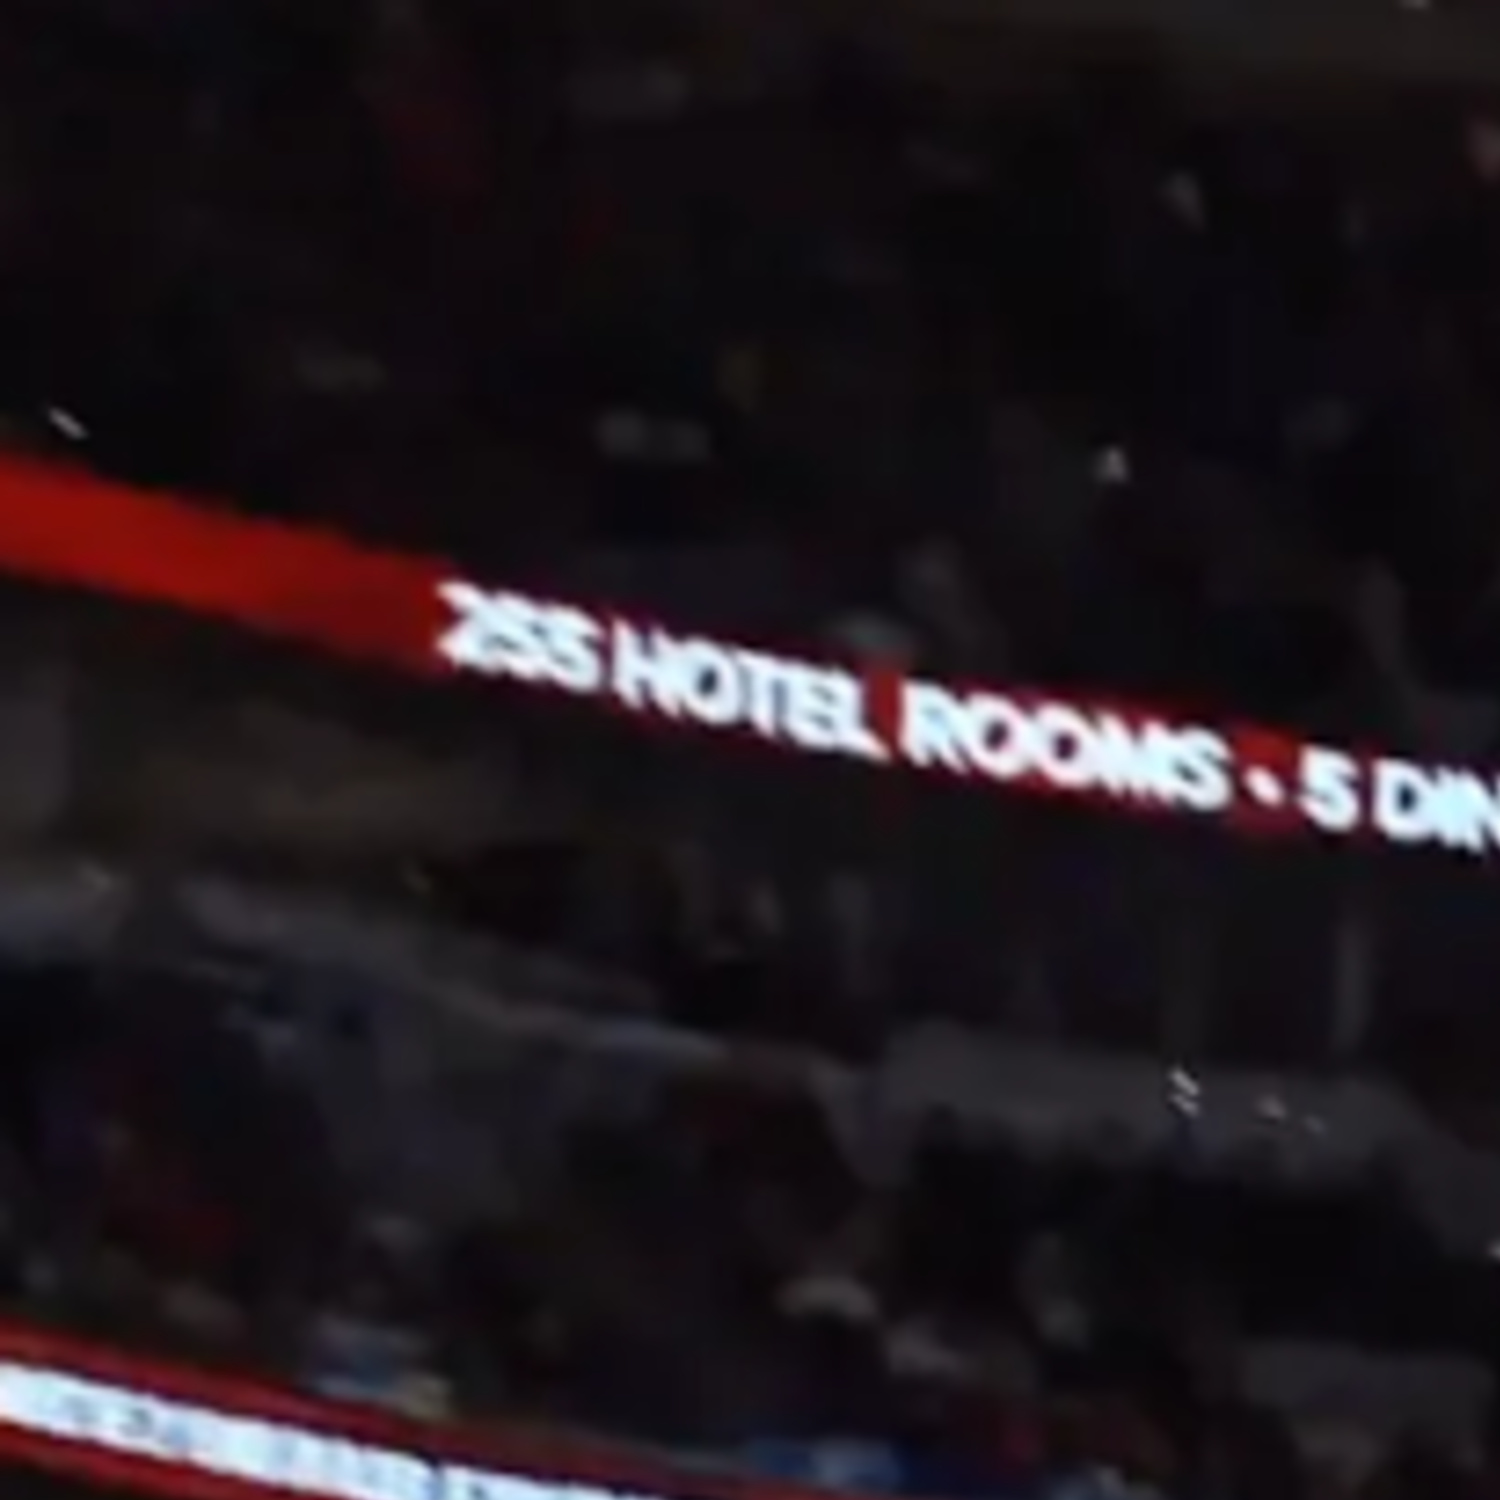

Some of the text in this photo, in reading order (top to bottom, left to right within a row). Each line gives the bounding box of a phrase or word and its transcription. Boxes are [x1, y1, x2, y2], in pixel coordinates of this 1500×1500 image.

[612, 614, 890, 762] HOTEL
[900, 680, 1232, 810] ROOMS
[1300, 746, 1358, 830] 5
